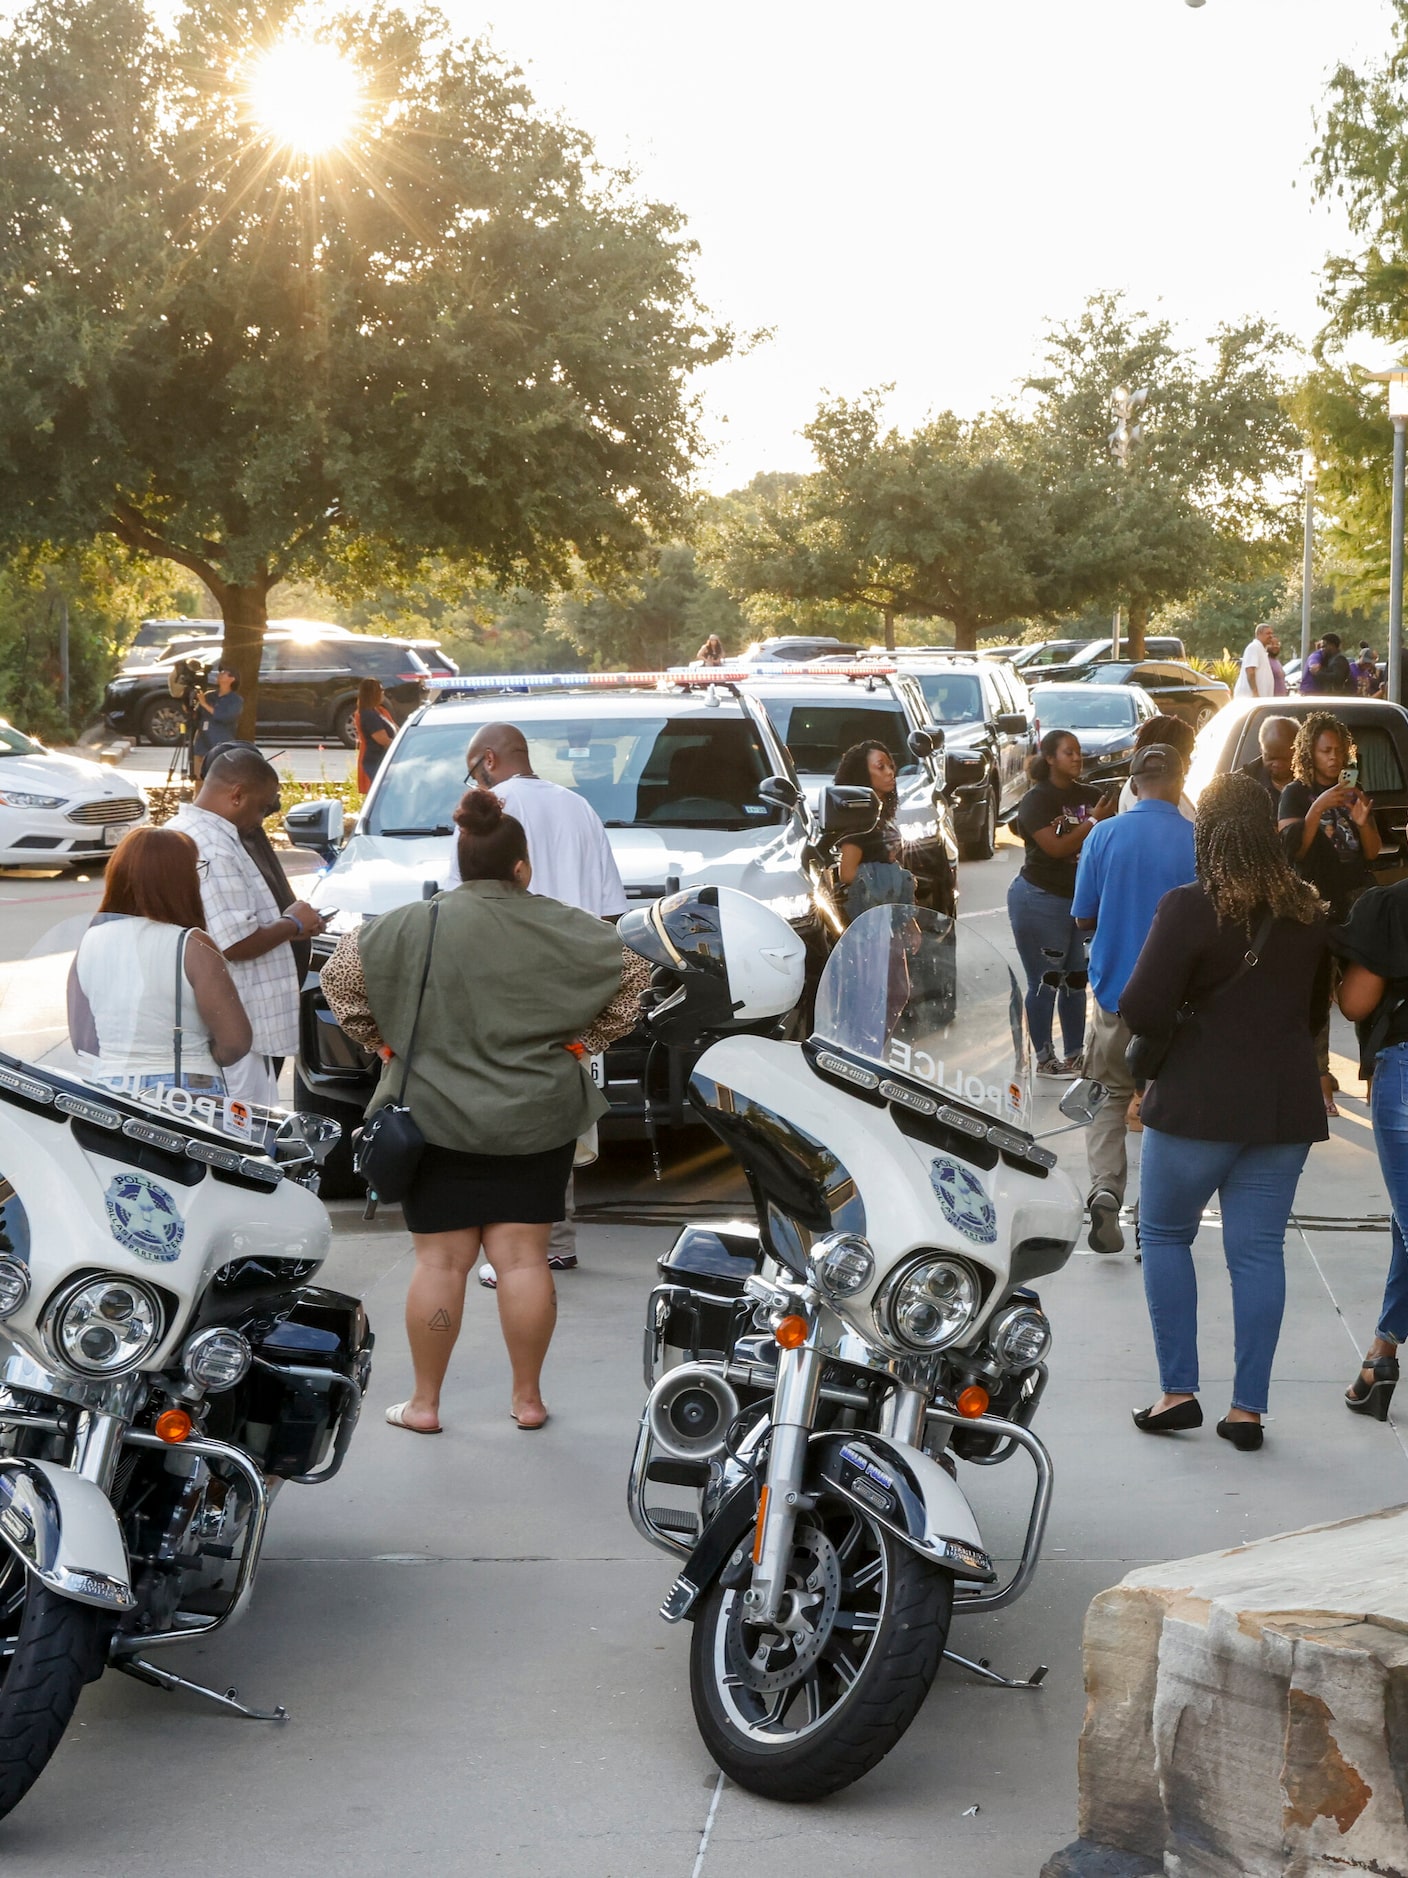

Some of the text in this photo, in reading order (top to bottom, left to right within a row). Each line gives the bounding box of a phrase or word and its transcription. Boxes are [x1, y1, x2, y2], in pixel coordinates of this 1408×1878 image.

[114, 1175, 173, 1202] POLICE
[106, 1200, 130, 1236] DALLAS
[115, 1235, 175, 1261] DEPARTMENT
[165, 1226, 184, 1250] TEXAS
